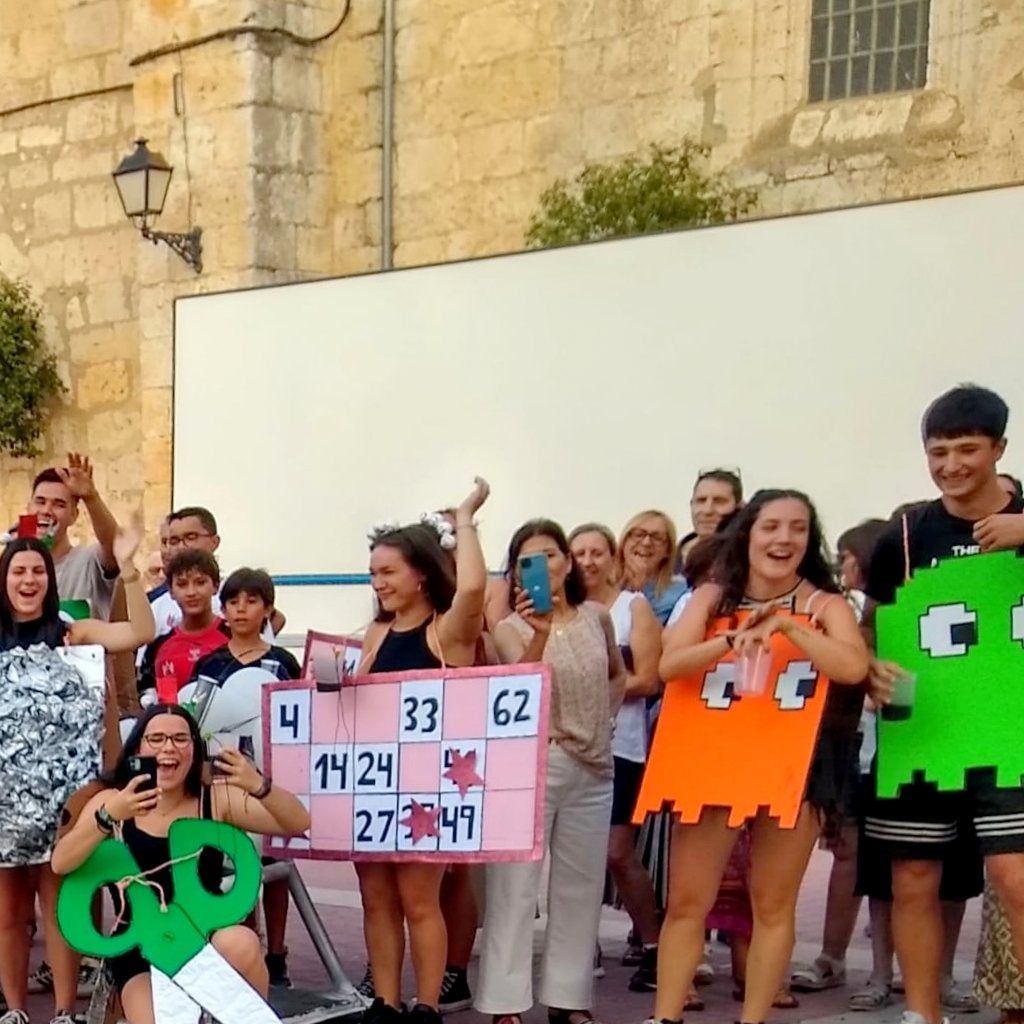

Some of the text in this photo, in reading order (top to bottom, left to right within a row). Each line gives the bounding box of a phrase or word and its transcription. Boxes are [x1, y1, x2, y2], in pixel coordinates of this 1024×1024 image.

[279, 689, 531, 739] 4 33 62
[314, 752, 393, 790] 14 24
[356, 809, 395, 842] 27
[442, 805, 476, 843] 49
